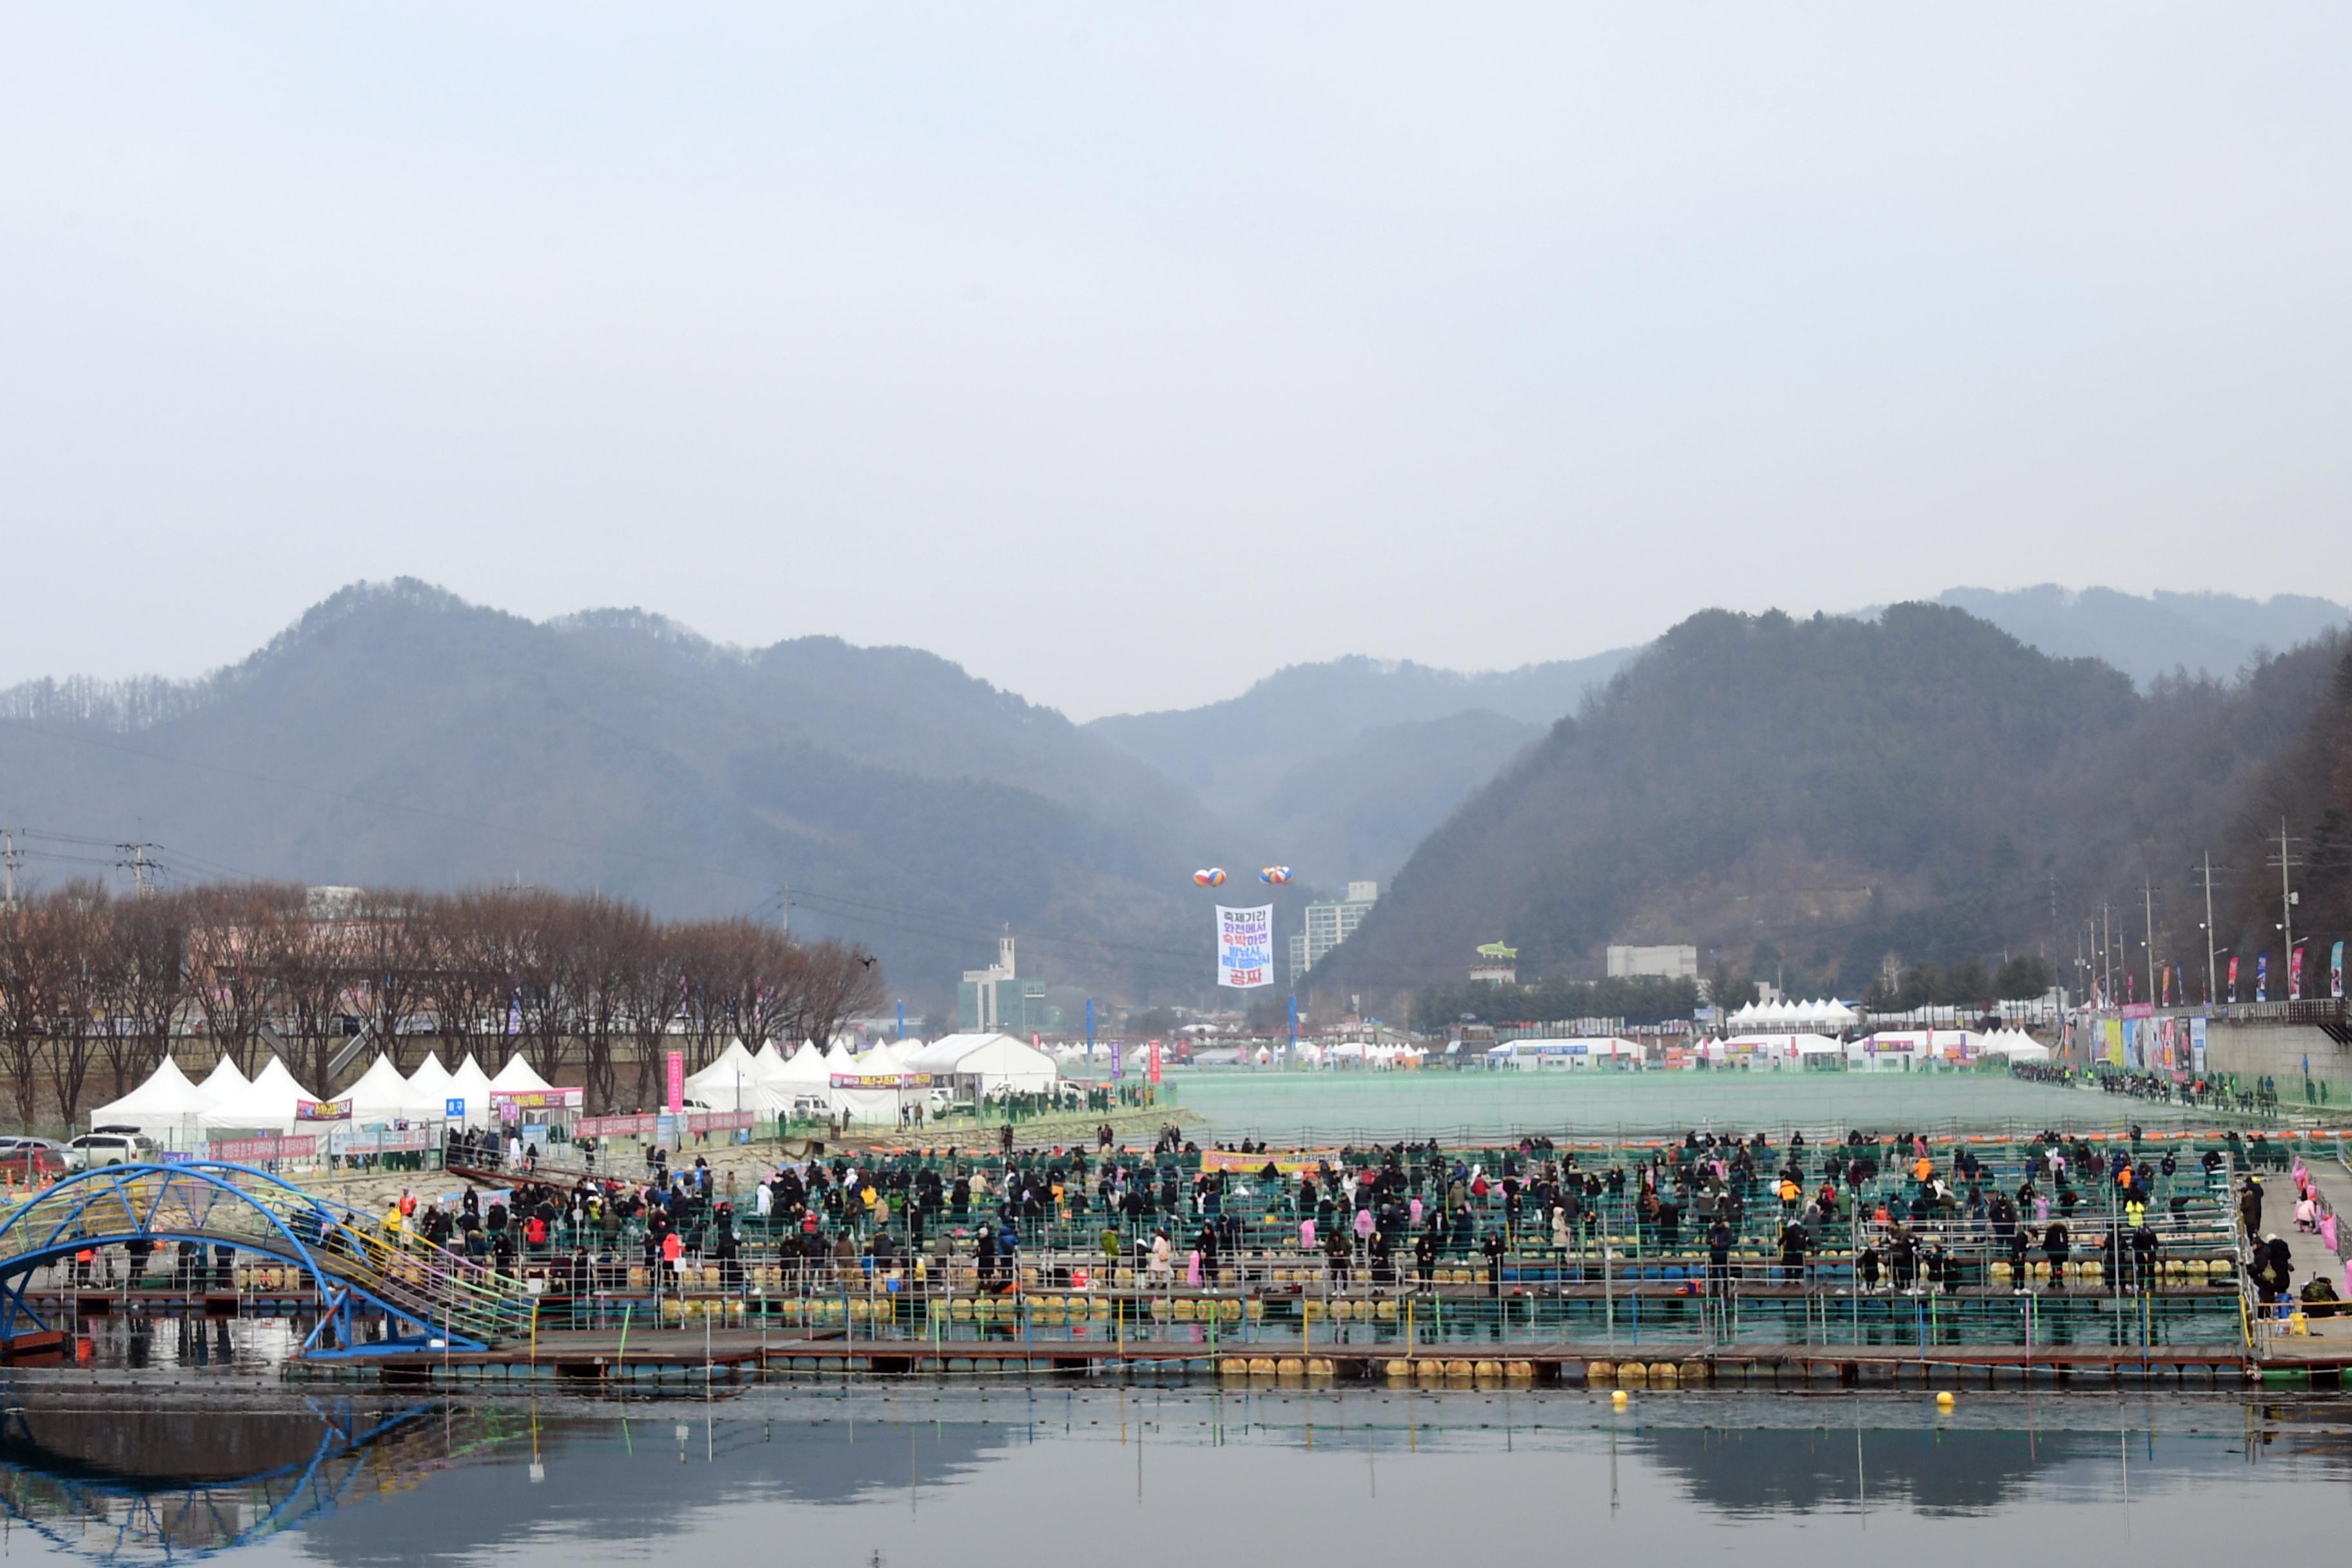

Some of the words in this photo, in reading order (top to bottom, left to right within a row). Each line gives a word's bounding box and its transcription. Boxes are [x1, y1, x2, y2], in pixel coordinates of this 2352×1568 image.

[1224, 910, 1266, 922] 축제기간
[1224, 921, 1266, 934] 화천에서
[1231, 968, 1261, 985] 공짜
